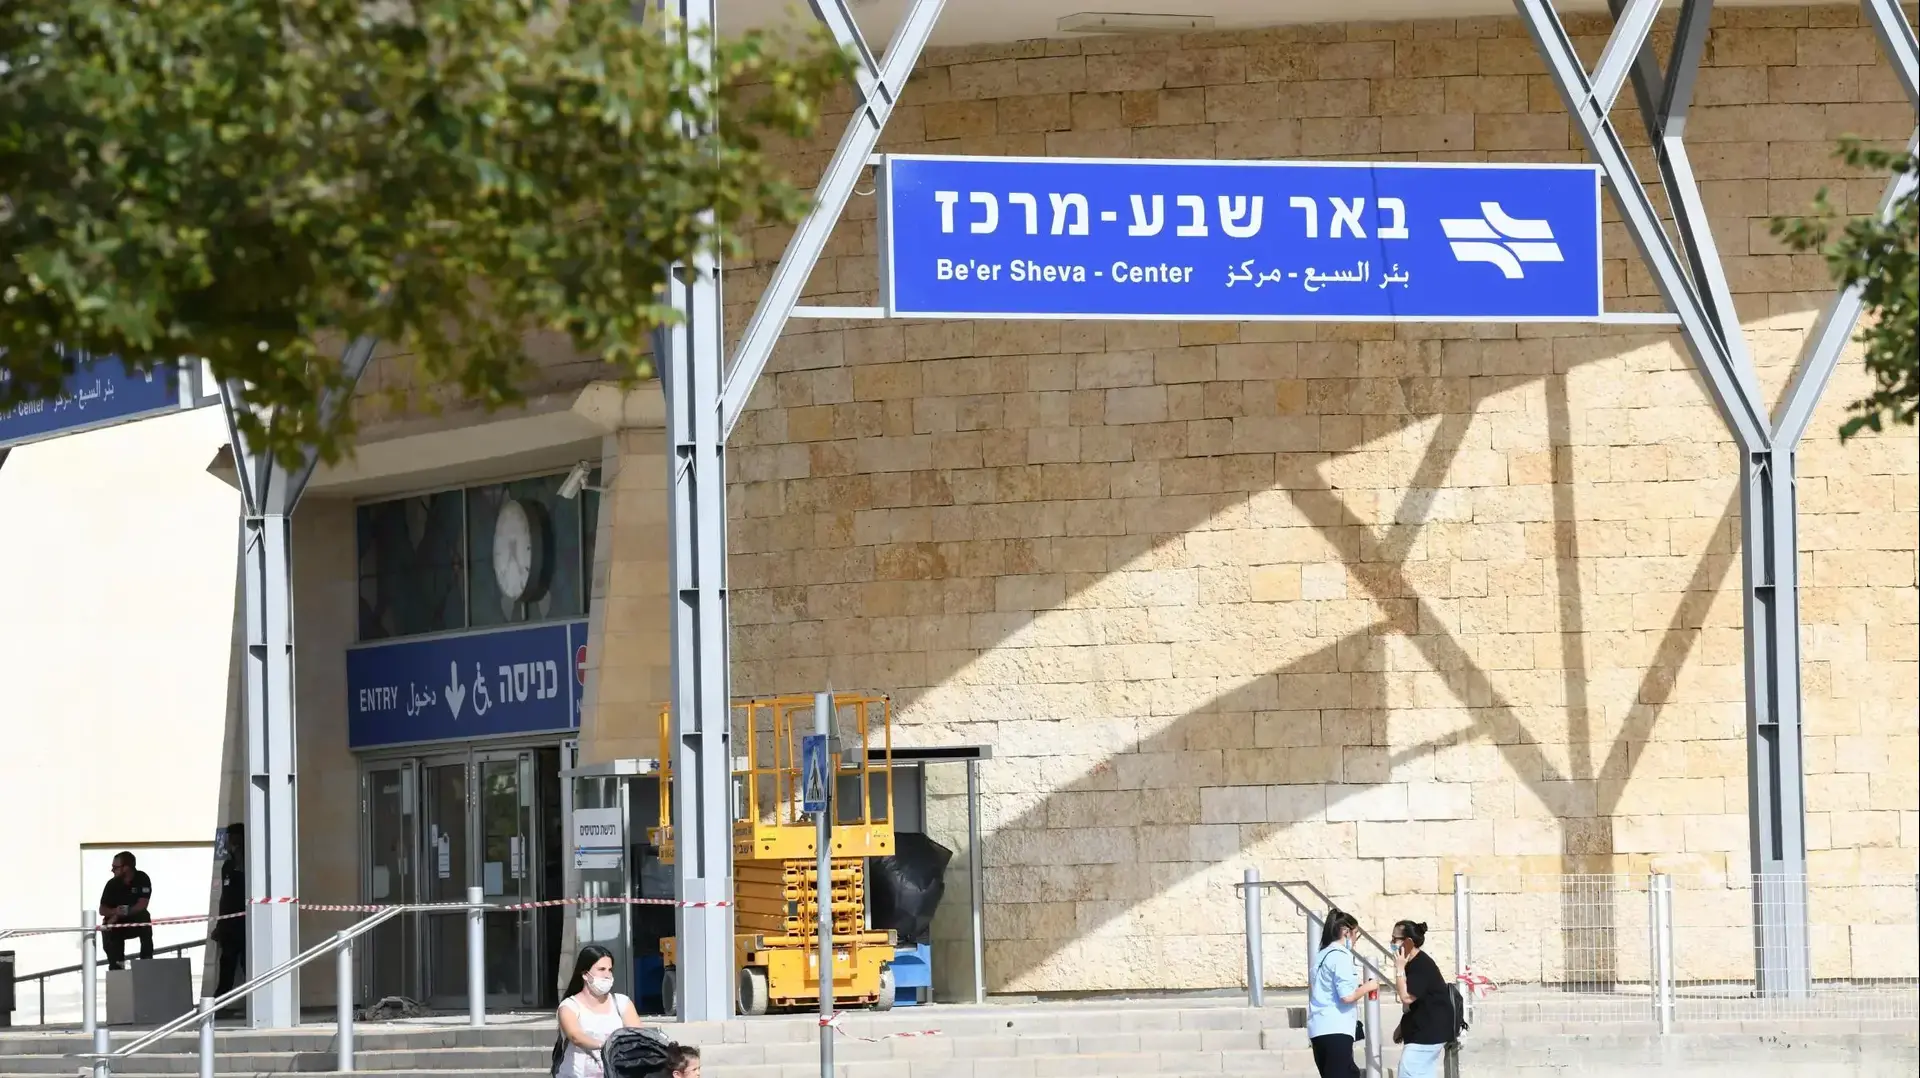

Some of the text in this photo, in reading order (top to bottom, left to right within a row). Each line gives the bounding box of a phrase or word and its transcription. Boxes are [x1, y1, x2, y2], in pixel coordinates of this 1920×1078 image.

[1289, 195, 1409, 239] באר
[937, 258, 1002, 282] Be'er
[1010, 259, 1086, 283] Sheva
[1111, 261, 1193, 284] Center
[1225, 259, 1282, 288] مركز
[1303, 260, 1370, 292] السبع
[1378, 263, 1410, 289] بئر
[499, 659, 559, 704] כניסה
[360, 686, 398, 712] ENTRY
[406, 681, 437, 717] دخول
